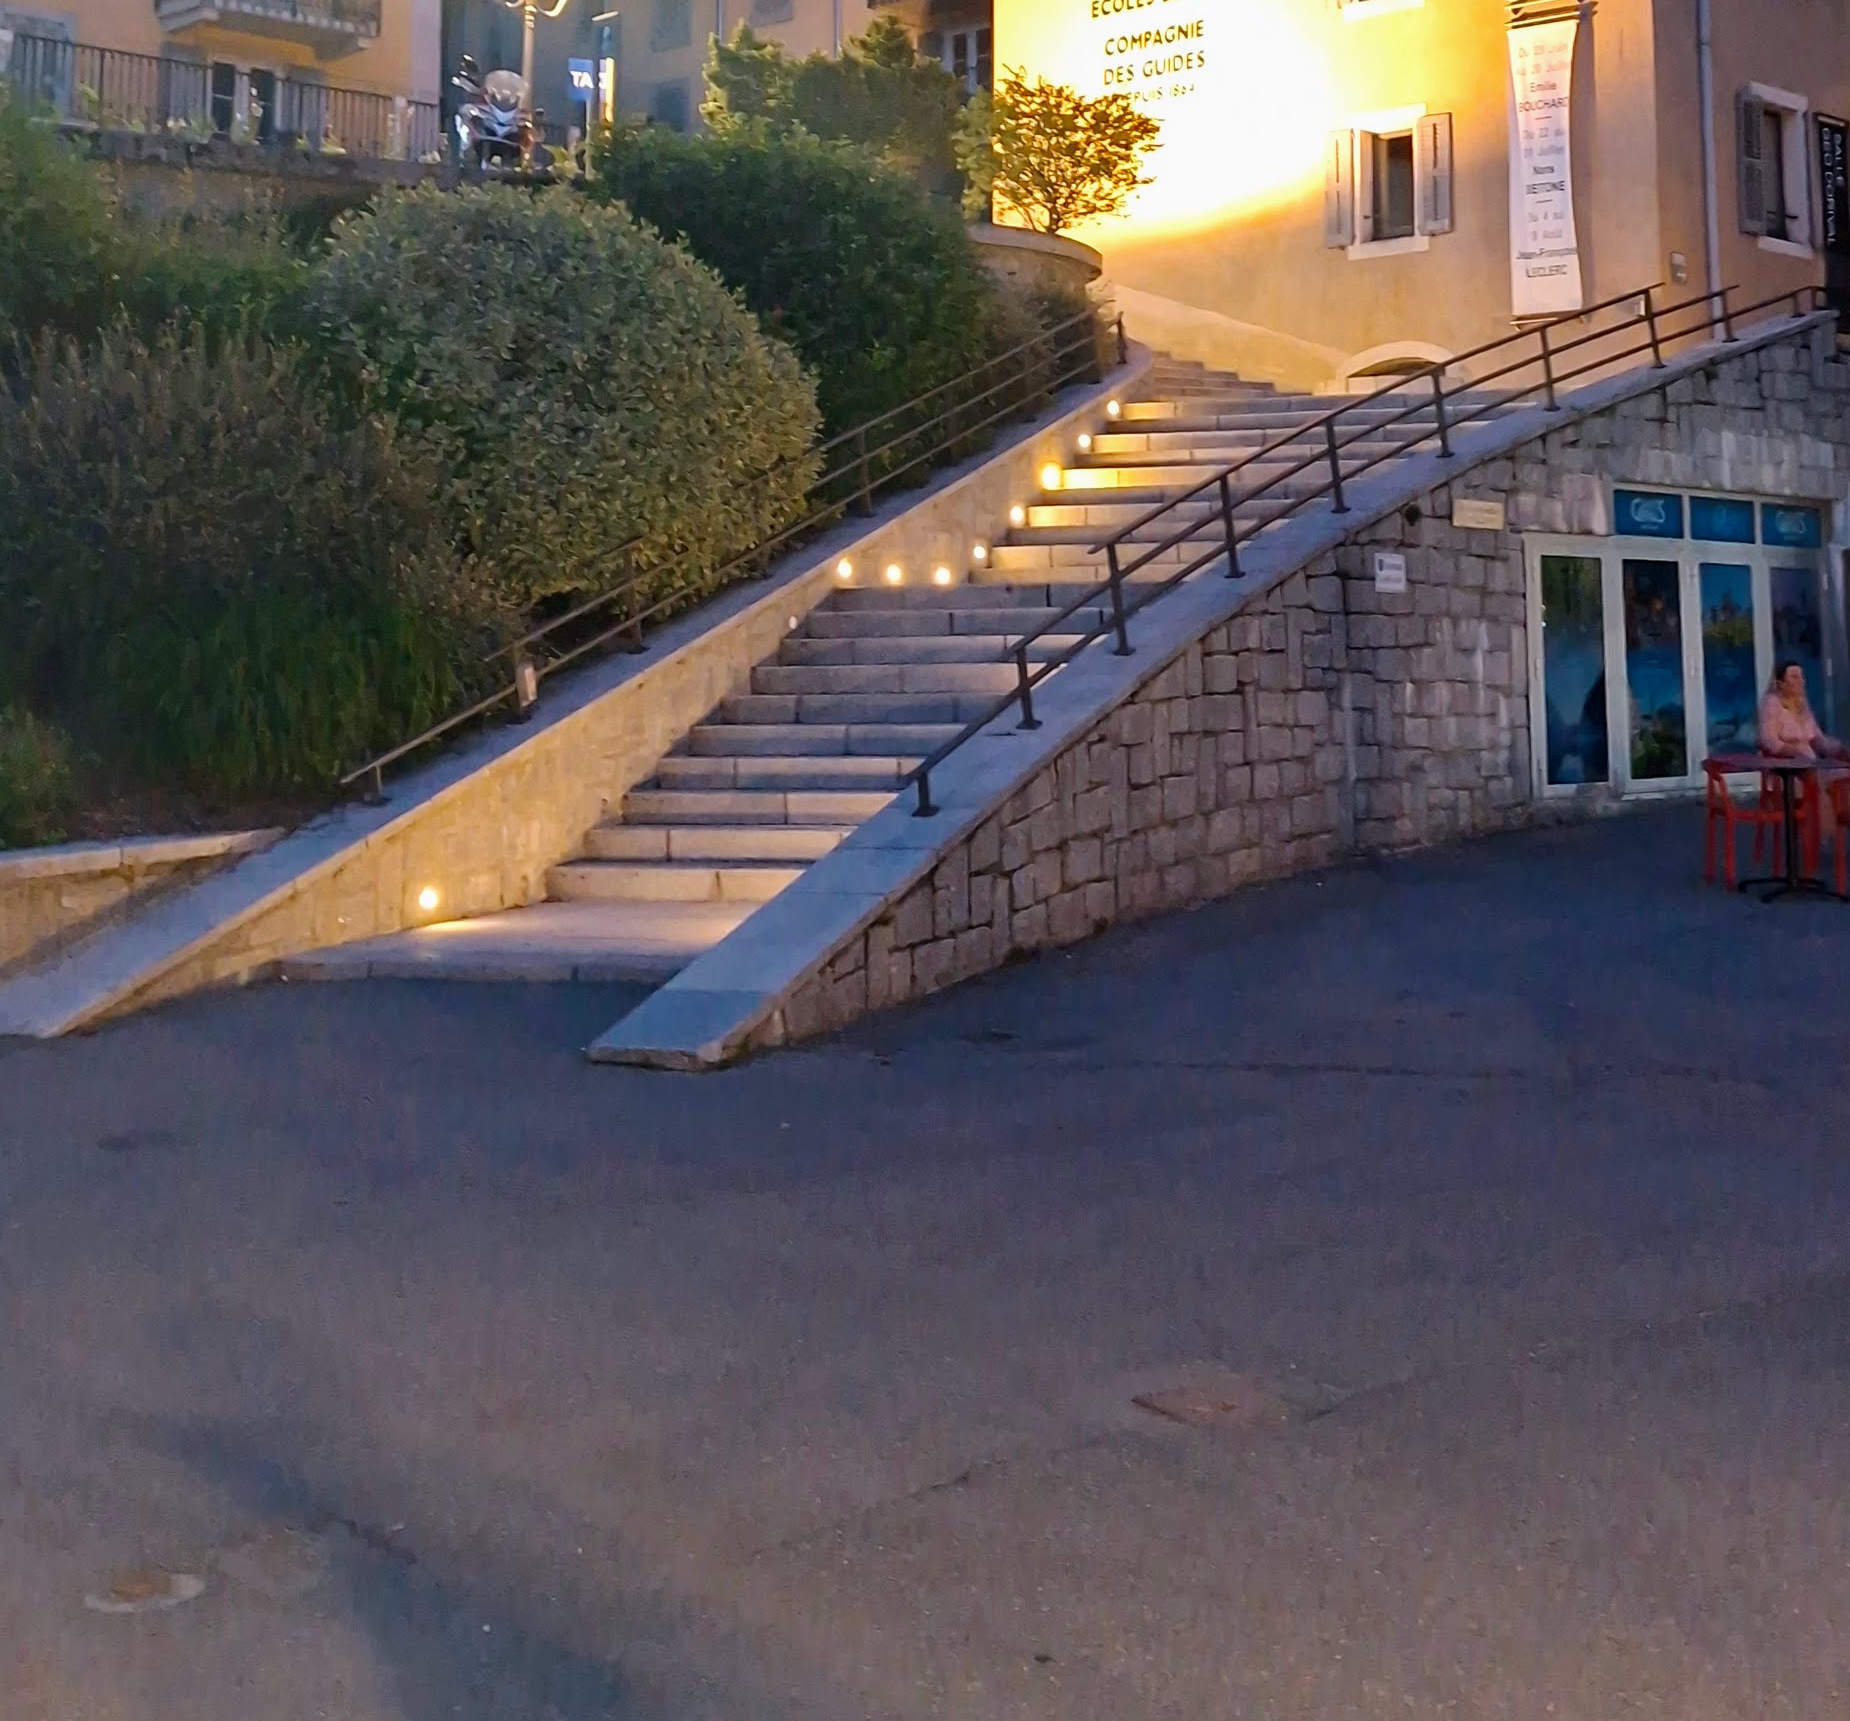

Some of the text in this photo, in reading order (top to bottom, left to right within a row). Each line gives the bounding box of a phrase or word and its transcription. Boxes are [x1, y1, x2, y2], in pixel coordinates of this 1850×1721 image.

[1105, 19, 1204, 56] COMPAGNIE
[1104, 50, 1205, 86] DES GUIDES
